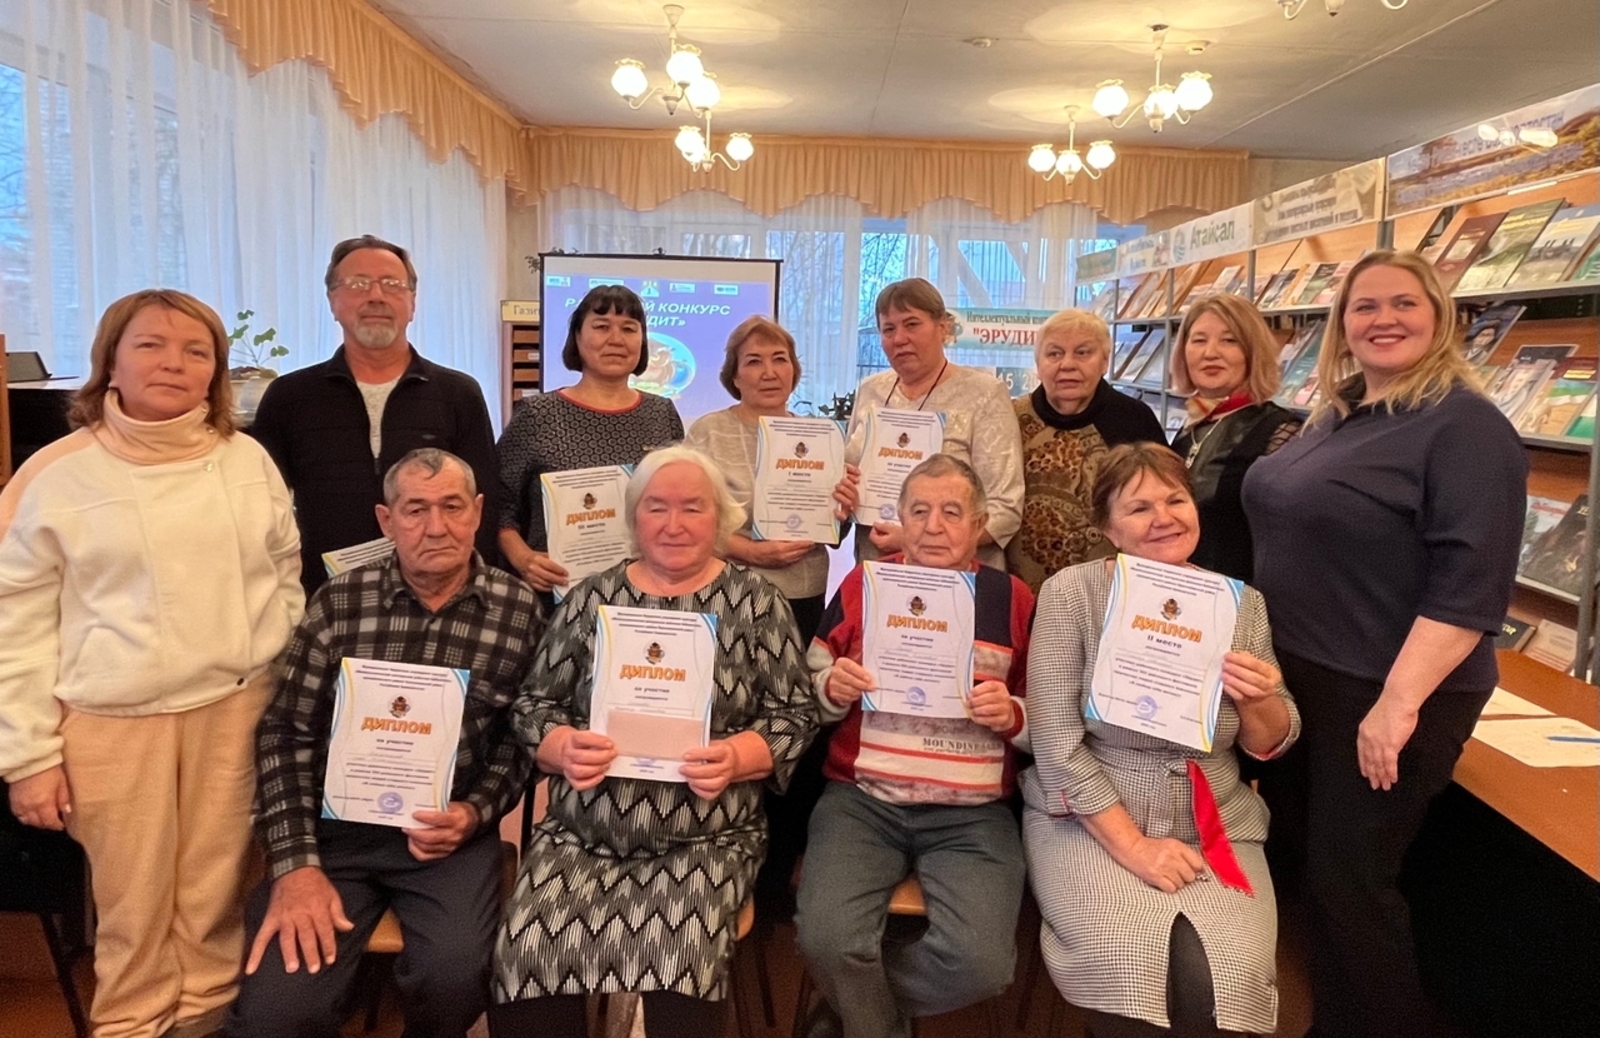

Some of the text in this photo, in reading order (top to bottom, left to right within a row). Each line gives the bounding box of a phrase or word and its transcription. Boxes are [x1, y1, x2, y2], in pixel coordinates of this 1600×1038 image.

[1190, 219, 1235, 250] Атайсал
[658, 302, 731, 315] КОНКУРС
[967, 311, 1031, 326] Интеллектуальный
[973, 328, 1037, 347] "ЭРУДИ
[878, 447, 923, 461] ДИПЛОМ
[776, 458, 825, 471] ДИПЛОМ
[566, 508, 616, 526] ДИПЛОМ
[886, 613, 949, 633] ДИПЛОМ
[1131, 613, 1203, 644] ДИПЛОМ
[1155, 638, 1183, 649] место
[619, 664, 687, 682] ДИПЛОМ
[361, 716, 432, 736] ДИПЛОМ
